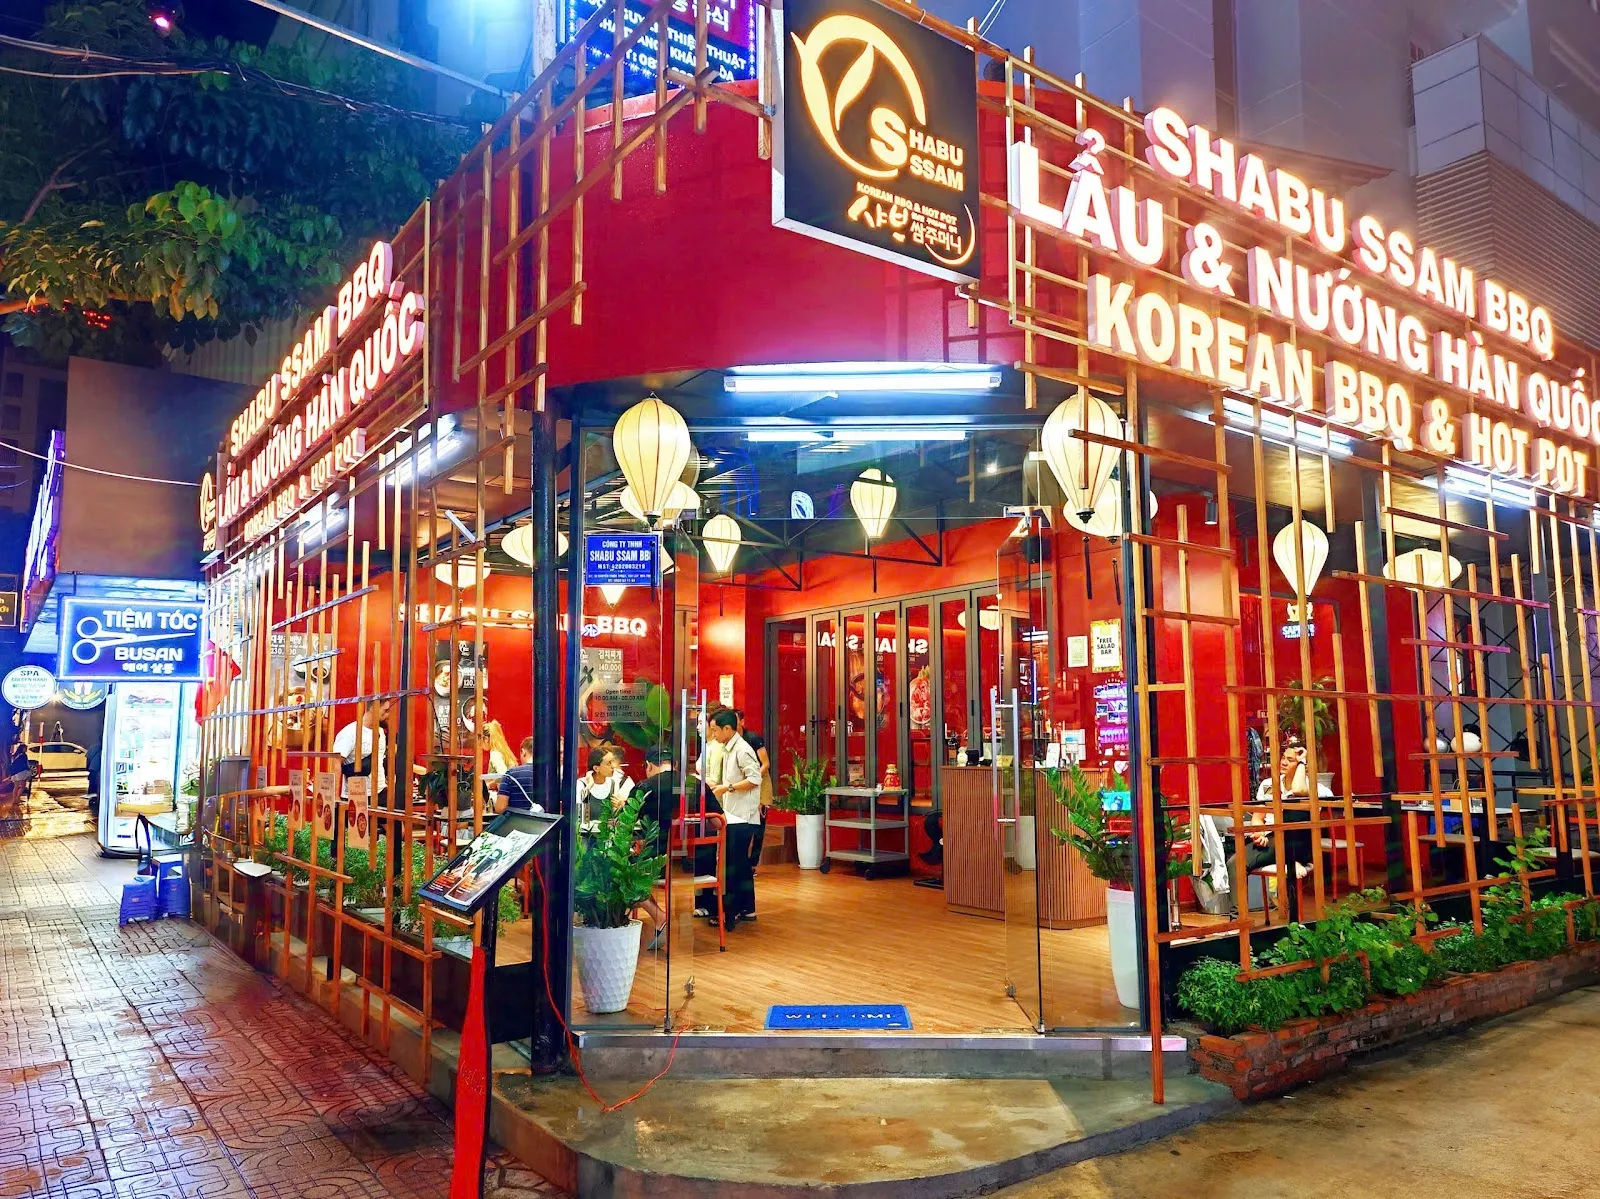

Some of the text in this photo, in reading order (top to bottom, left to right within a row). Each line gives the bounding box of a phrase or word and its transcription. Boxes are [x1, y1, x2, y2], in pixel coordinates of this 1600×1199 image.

[706, 43, 747, 70] THUẬT
[909, 154, 964, 192] SSAM
[856, 181, 894, 204] KOREAN
[894, 195, 913, 211] BBQ
[913, 202, 921, 213] &
[921, 205, 940, 220] HOT
[940, 212, 958, 226] POT
[1144, 106, 1556, 361] SHABU SSAM BBQ
[1008, 127, 1164, 267] LẨU
[1181, 222, 1236, 297] &
[1247, 245, 1431, 376] NƯỚNG
[1433, 329, 1519, 411] HÀN
[230, 240, 393, 458] SHABU SSAM BBQ
[240, 468, 251, 509] &
[305, 367, 349, 449] HÀN
[349, 280, 426, 406] QUỐC
[1086, 272, 1589, 498] KOREAN BBQ & HOT POT
[298, 474, 312, 500] &
[310, 450, 337, 492] HOT
[334, 426, 368, 473] POT
[590, 549, 615, 562] SHABU
[616, 549, 638, 562] SSAM
[601, 540, 643, 549] CÔNG TY TNHH
[102, 607, 198, 632] TIỆM TÓC
[597, 615, 647, 638] BBQ
[114, 646, 183, 662] BUSAN
